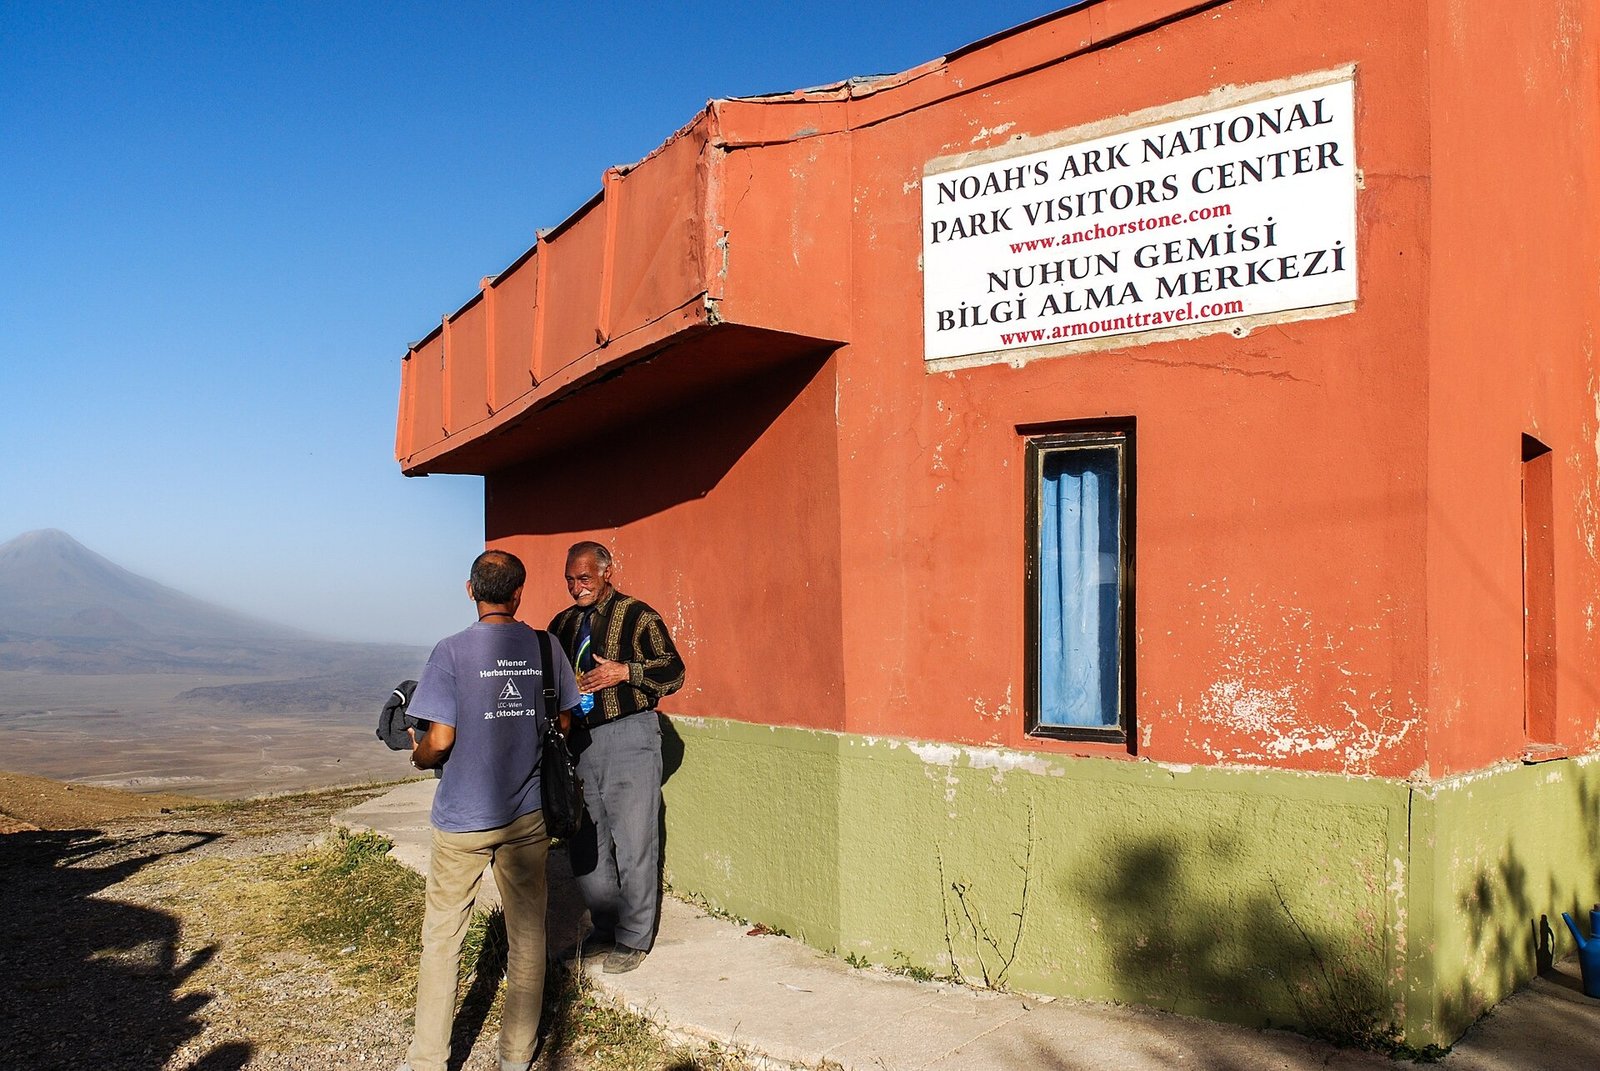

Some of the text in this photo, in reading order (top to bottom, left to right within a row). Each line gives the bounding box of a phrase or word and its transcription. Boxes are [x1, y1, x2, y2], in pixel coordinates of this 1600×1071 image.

[930, 141, 1344, 244] PARK VISITORS CENTER
[937, 98, 1334, 205] NOAH'S ARK NATIONAL
[987, 216, 1278, 294] NUHUN GEMİSİ
[1009, 202, 1232, 254] www.anchorstone.com
[937, 240, 1347, 332] BİLGİ ALMA MERKEZİ
[1000, 298, 1244, 345] www.armounttravel.com
